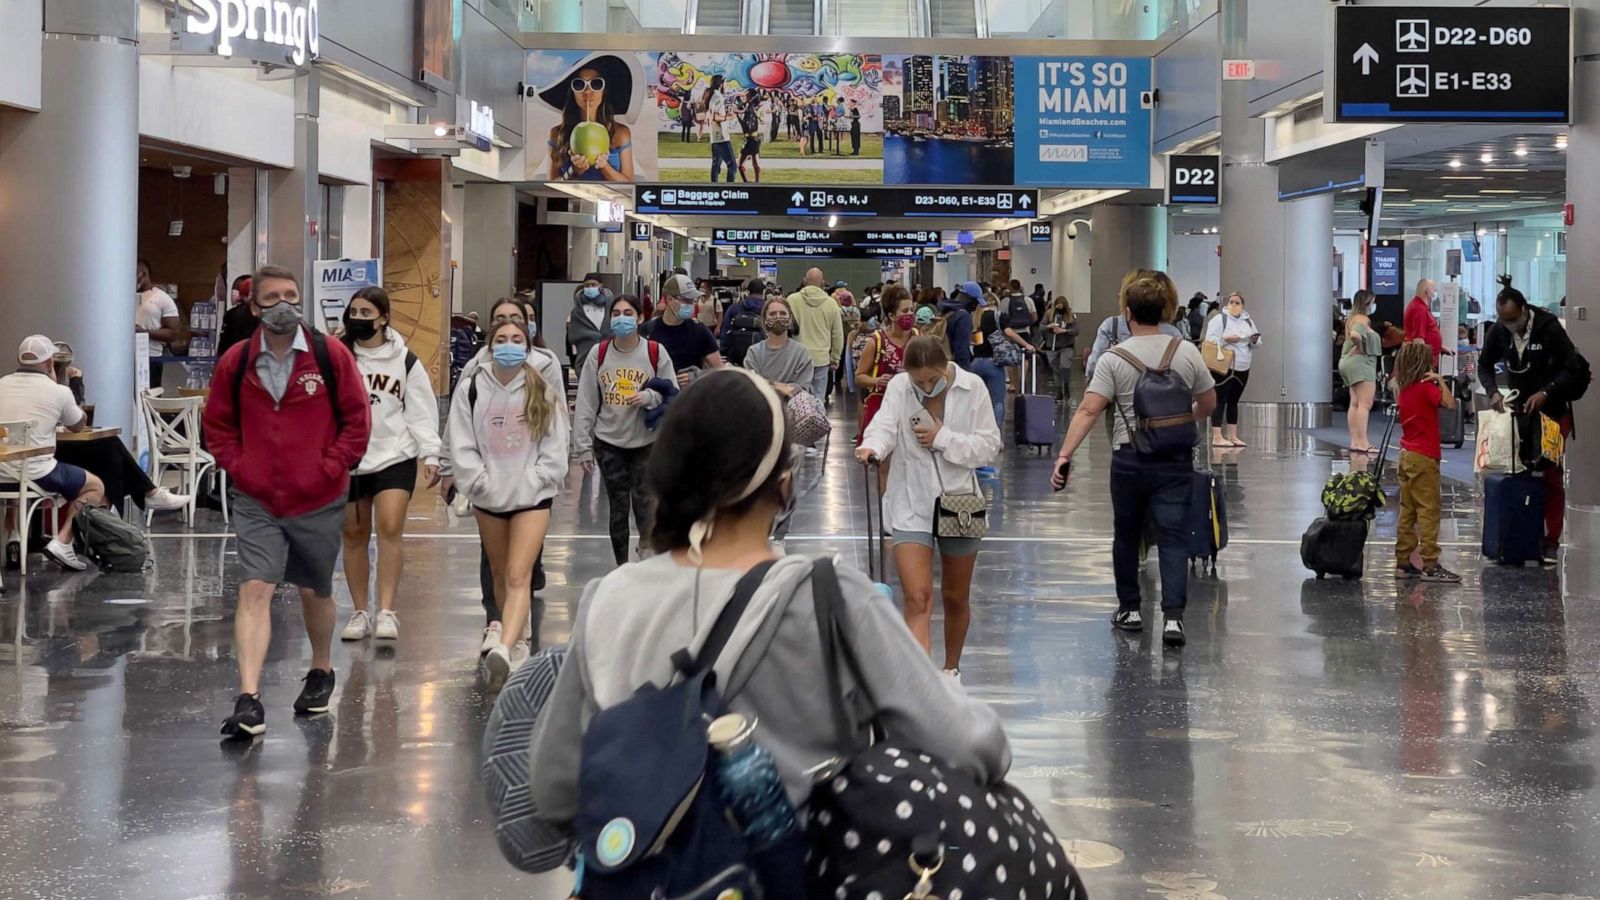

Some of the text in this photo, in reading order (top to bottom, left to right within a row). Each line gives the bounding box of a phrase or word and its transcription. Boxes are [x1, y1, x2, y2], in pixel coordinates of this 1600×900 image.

[187, 0, 306, 65] Spring
[1039, 62, 1127, 86] IT'S SO
[1228, 63, 1249, 77] EXIT
[1435, 72, 1512, 90] E1-E33
[1039, 88, 1127, 113] MIAMI
[1039, 118, 1126, 127] MiamiandBeaches.com
[1175, 167, 1215, 185] D22
[678, 190, 749, 200] Baggage Claim
[861, 195, 868, 204] J
[962, 197, 995, 205] E1-E33
[737, 231, 759, 239] EXIT
[1032, 226, 1050, 235] D23
[756, 245, 774, 253] EXIT
[367, 374, 400, 398] WA
